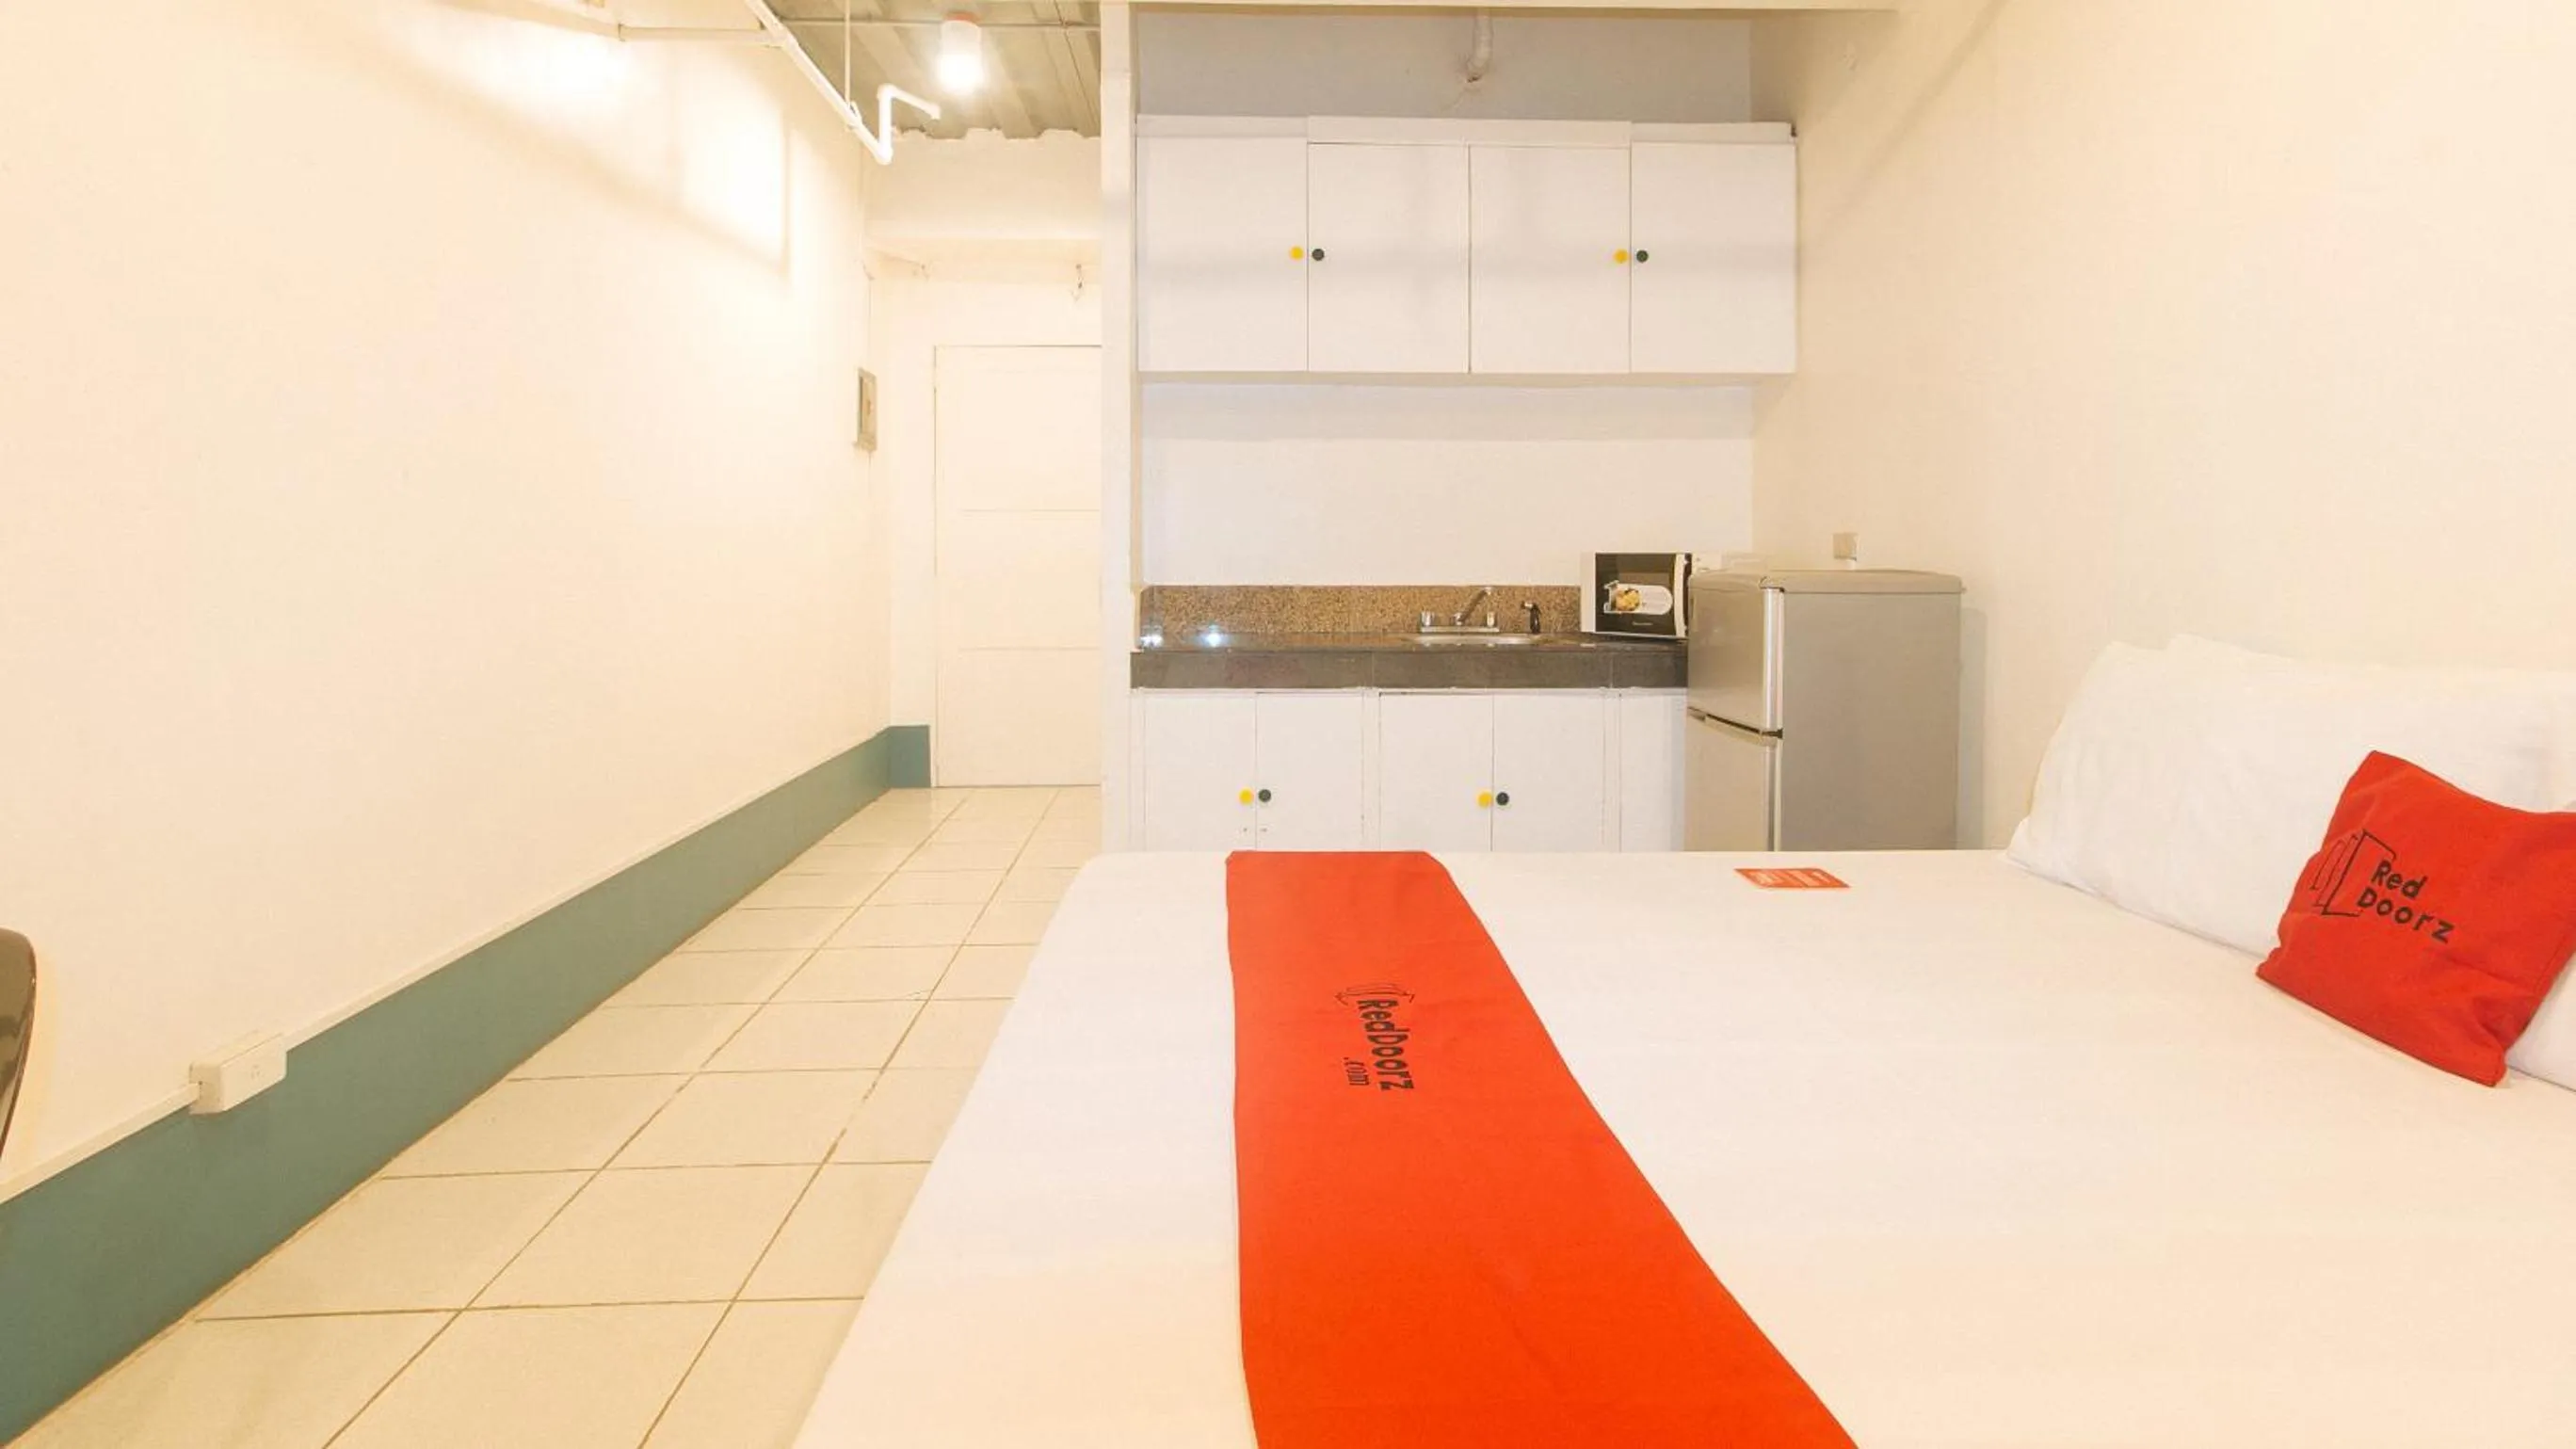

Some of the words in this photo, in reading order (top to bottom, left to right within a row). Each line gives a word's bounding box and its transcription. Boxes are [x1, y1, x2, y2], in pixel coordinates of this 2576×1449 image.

[2371, 860, 2427, 898] Red
[2357, 888, 2455, 943] Doorz
[1357, 1000, 1414, 1091] RedDoorz
